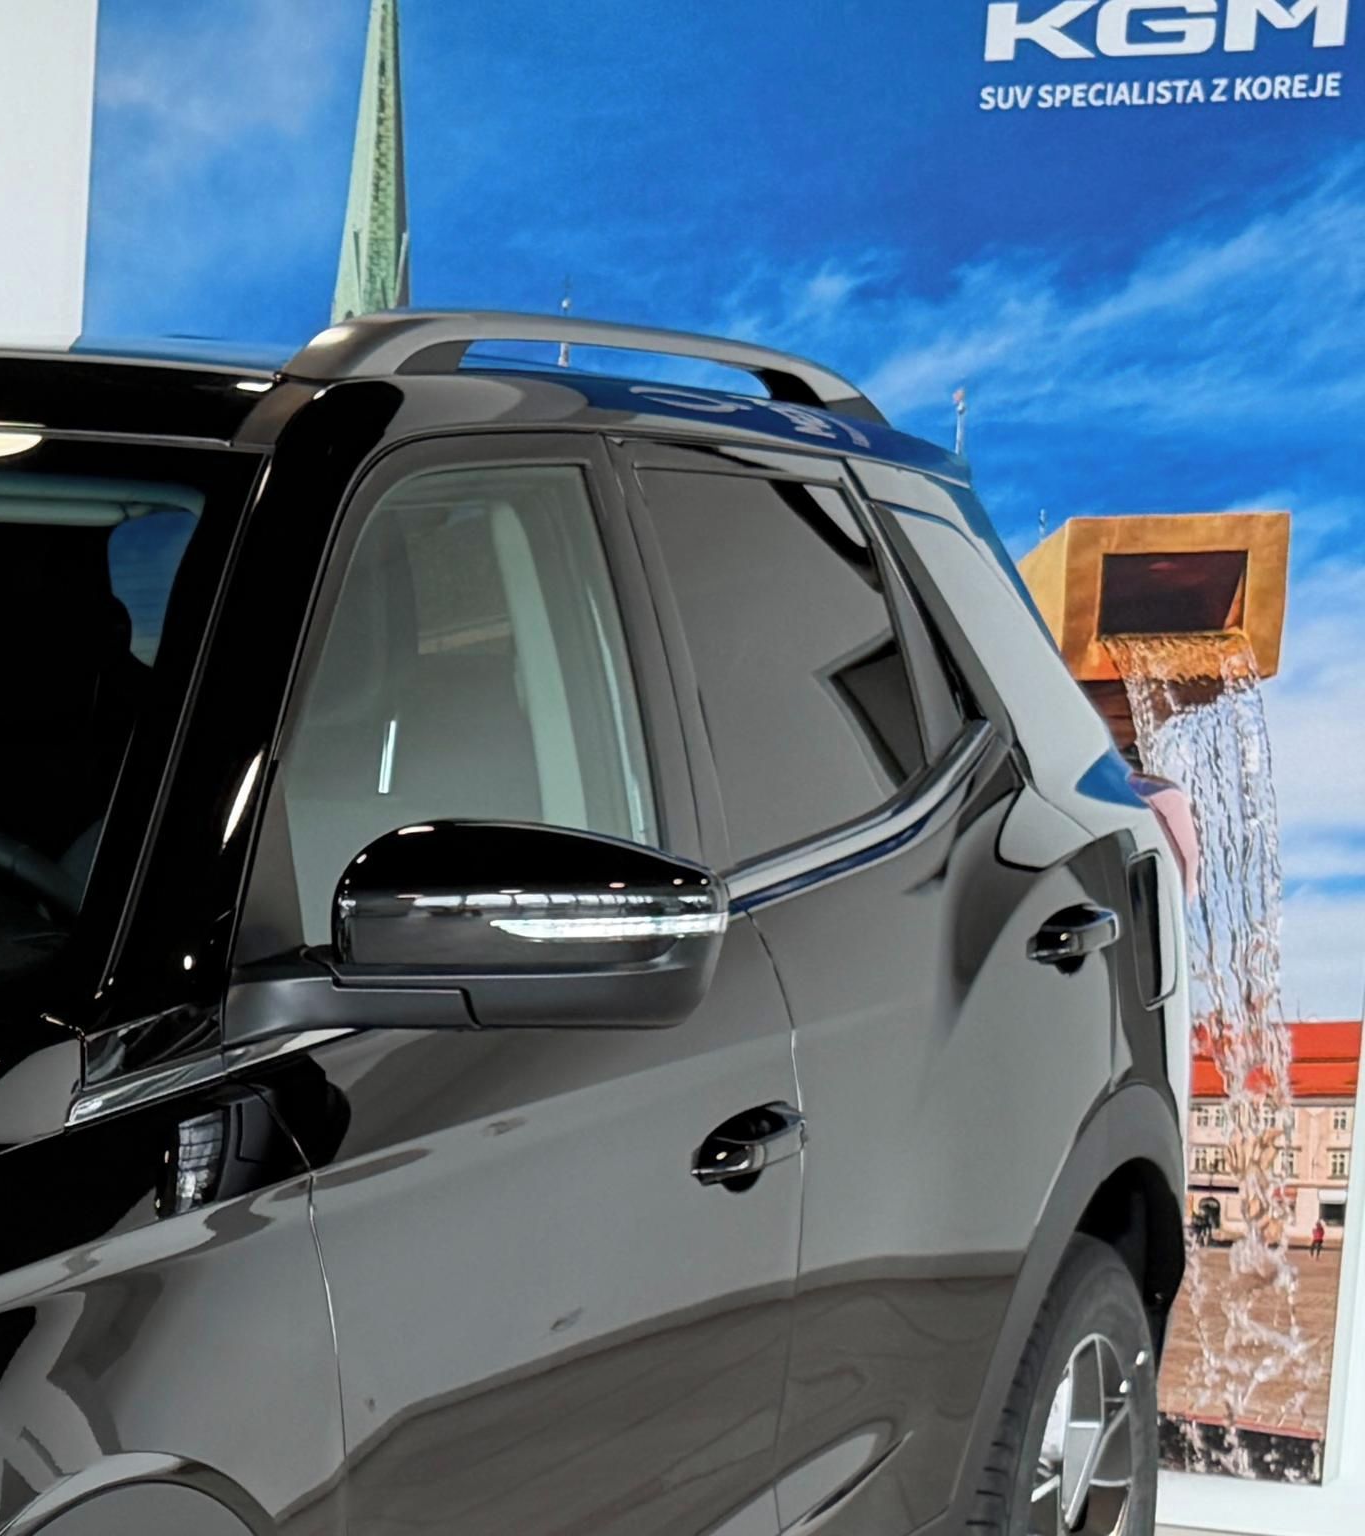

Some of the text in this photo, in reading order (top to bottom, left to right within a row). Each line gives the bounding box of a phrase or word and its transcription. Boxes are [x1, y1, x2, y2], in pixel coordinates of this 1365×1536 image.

[984, 0, 1349, 62] KGM
[979, 72, 1343, 111] SUV SPECIALISTA Z KOREJE
